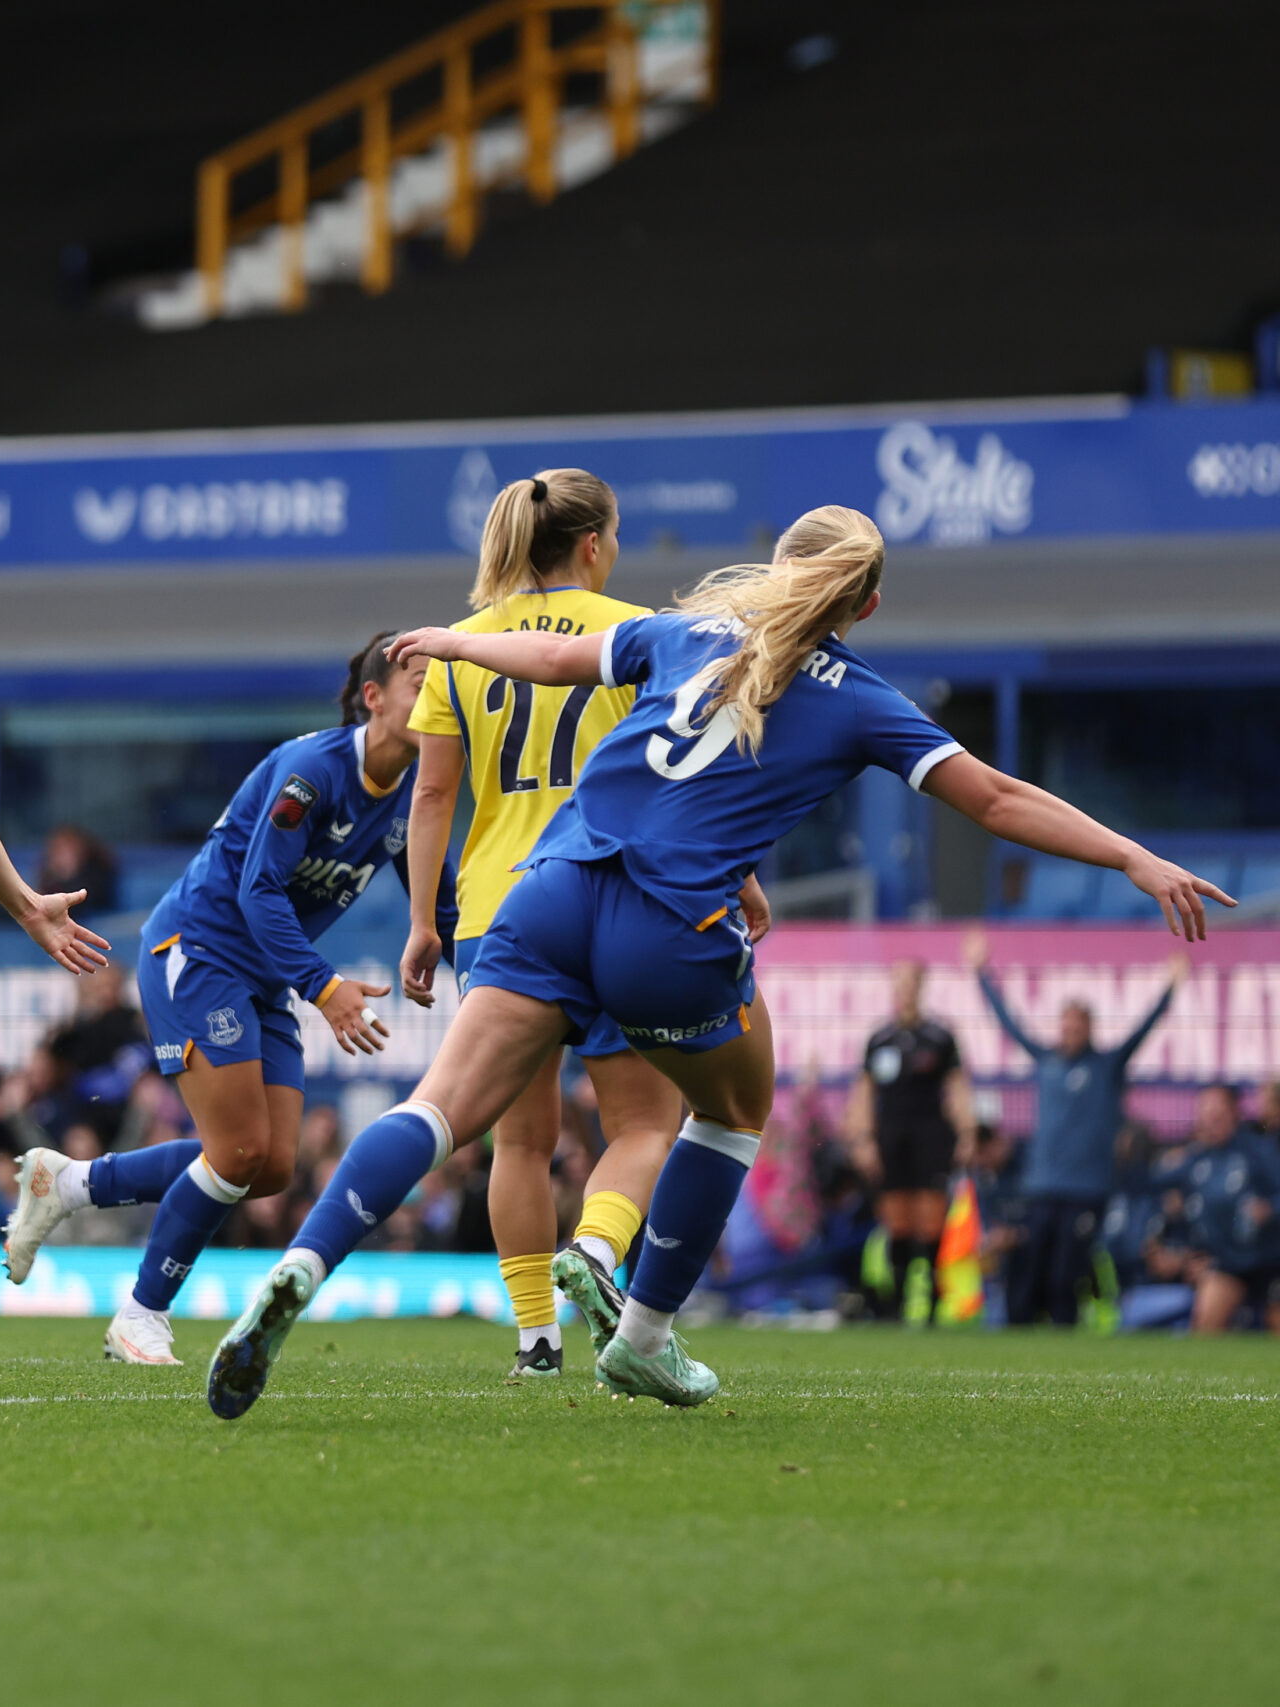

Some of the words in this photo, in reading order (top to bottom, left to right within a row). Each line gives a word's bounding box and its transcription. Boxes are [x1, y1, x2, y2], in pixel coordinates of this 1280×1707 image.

[503, 615, 586, 637] ARRI
[484, 674, 601, 795] 27
[644, 657, 743, 781] 9
